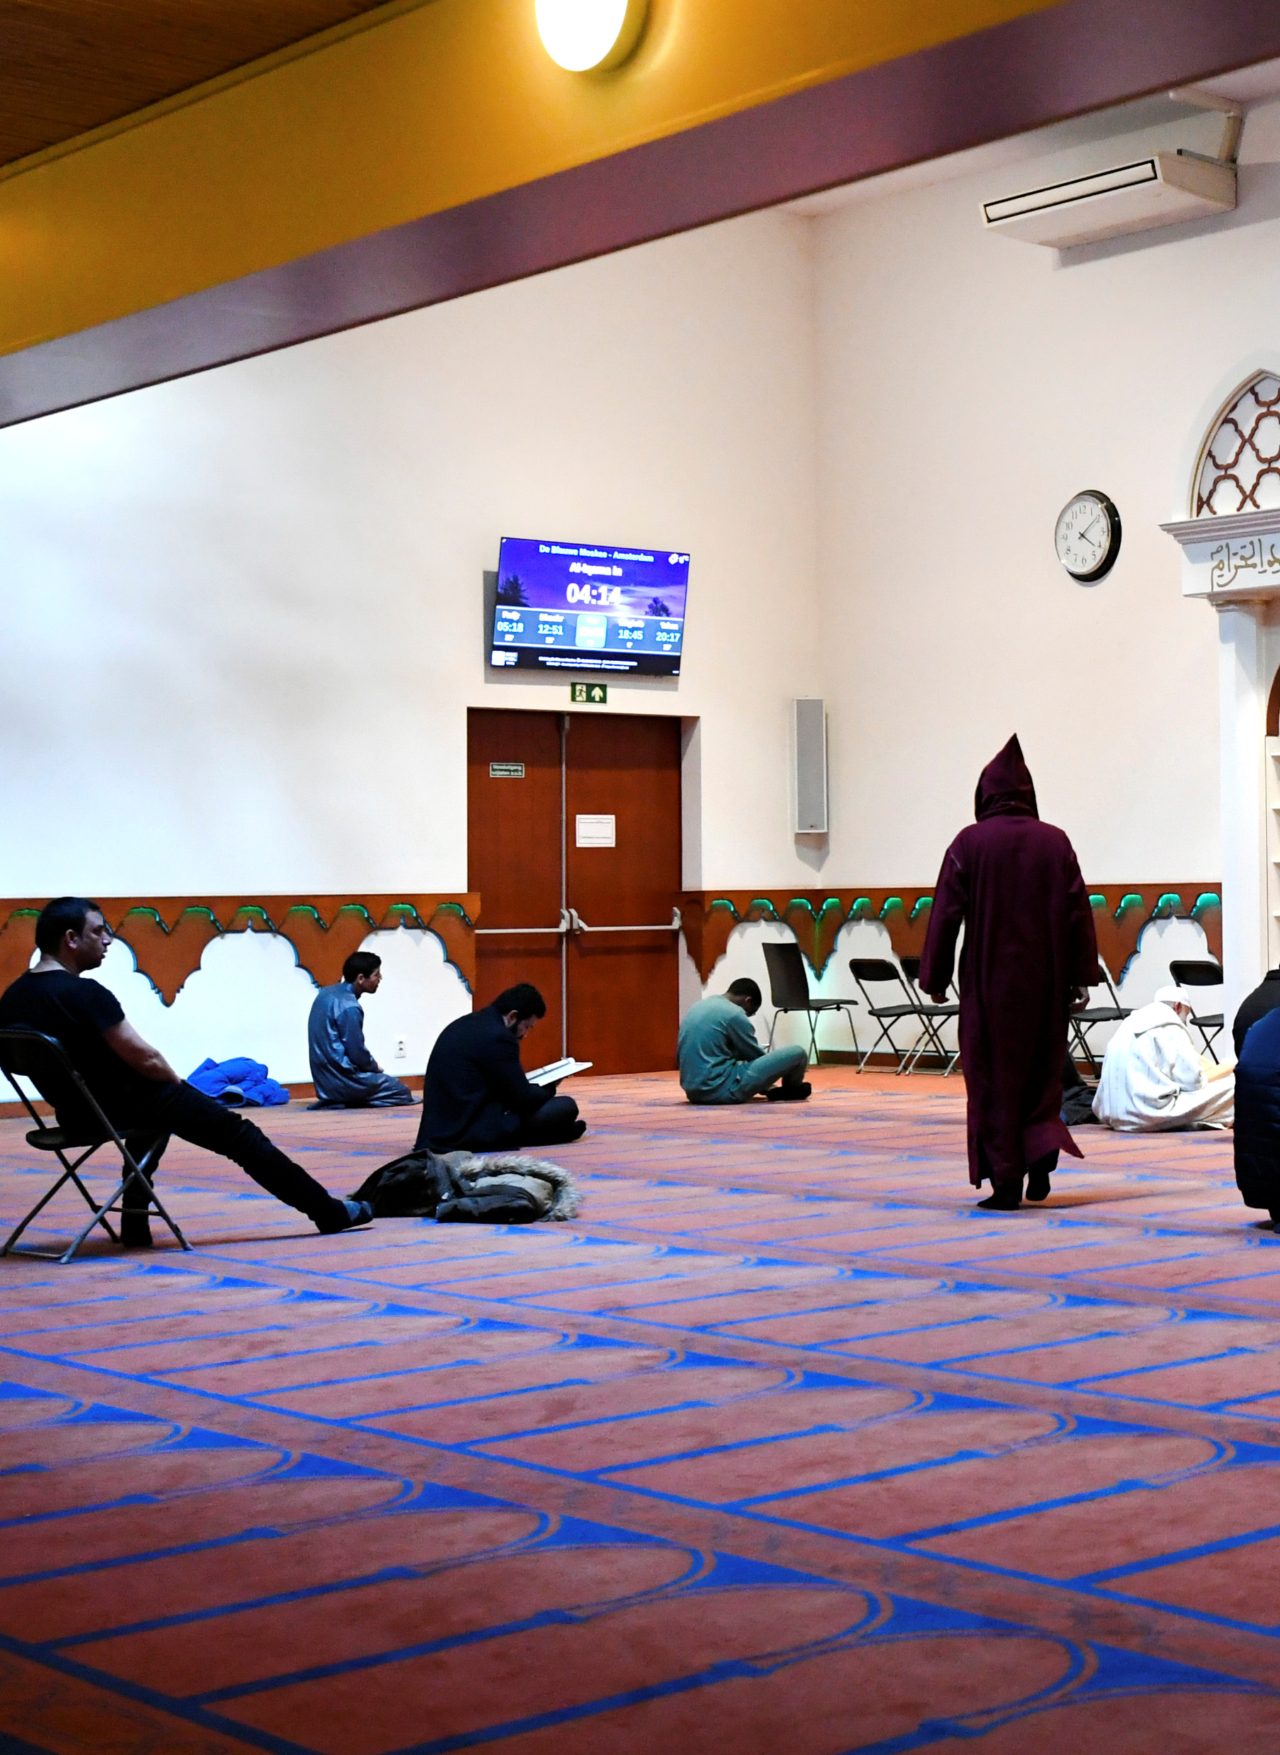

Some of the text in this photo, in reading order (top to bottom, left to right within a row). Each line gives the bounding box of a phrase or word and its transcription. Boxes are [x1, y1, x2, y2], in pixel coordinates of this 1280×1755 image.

[539, 544, 550, 554] De
[612, 551, 654, 563] Amsterdam
[566, 583, 622, 606] 04:14
[497, 621, 524, 634] 05:18
[537, 624, 564, 636] 12:51
[618, 629, 644, 641] 18:45
[655, 631, 681, 643] 20:17
